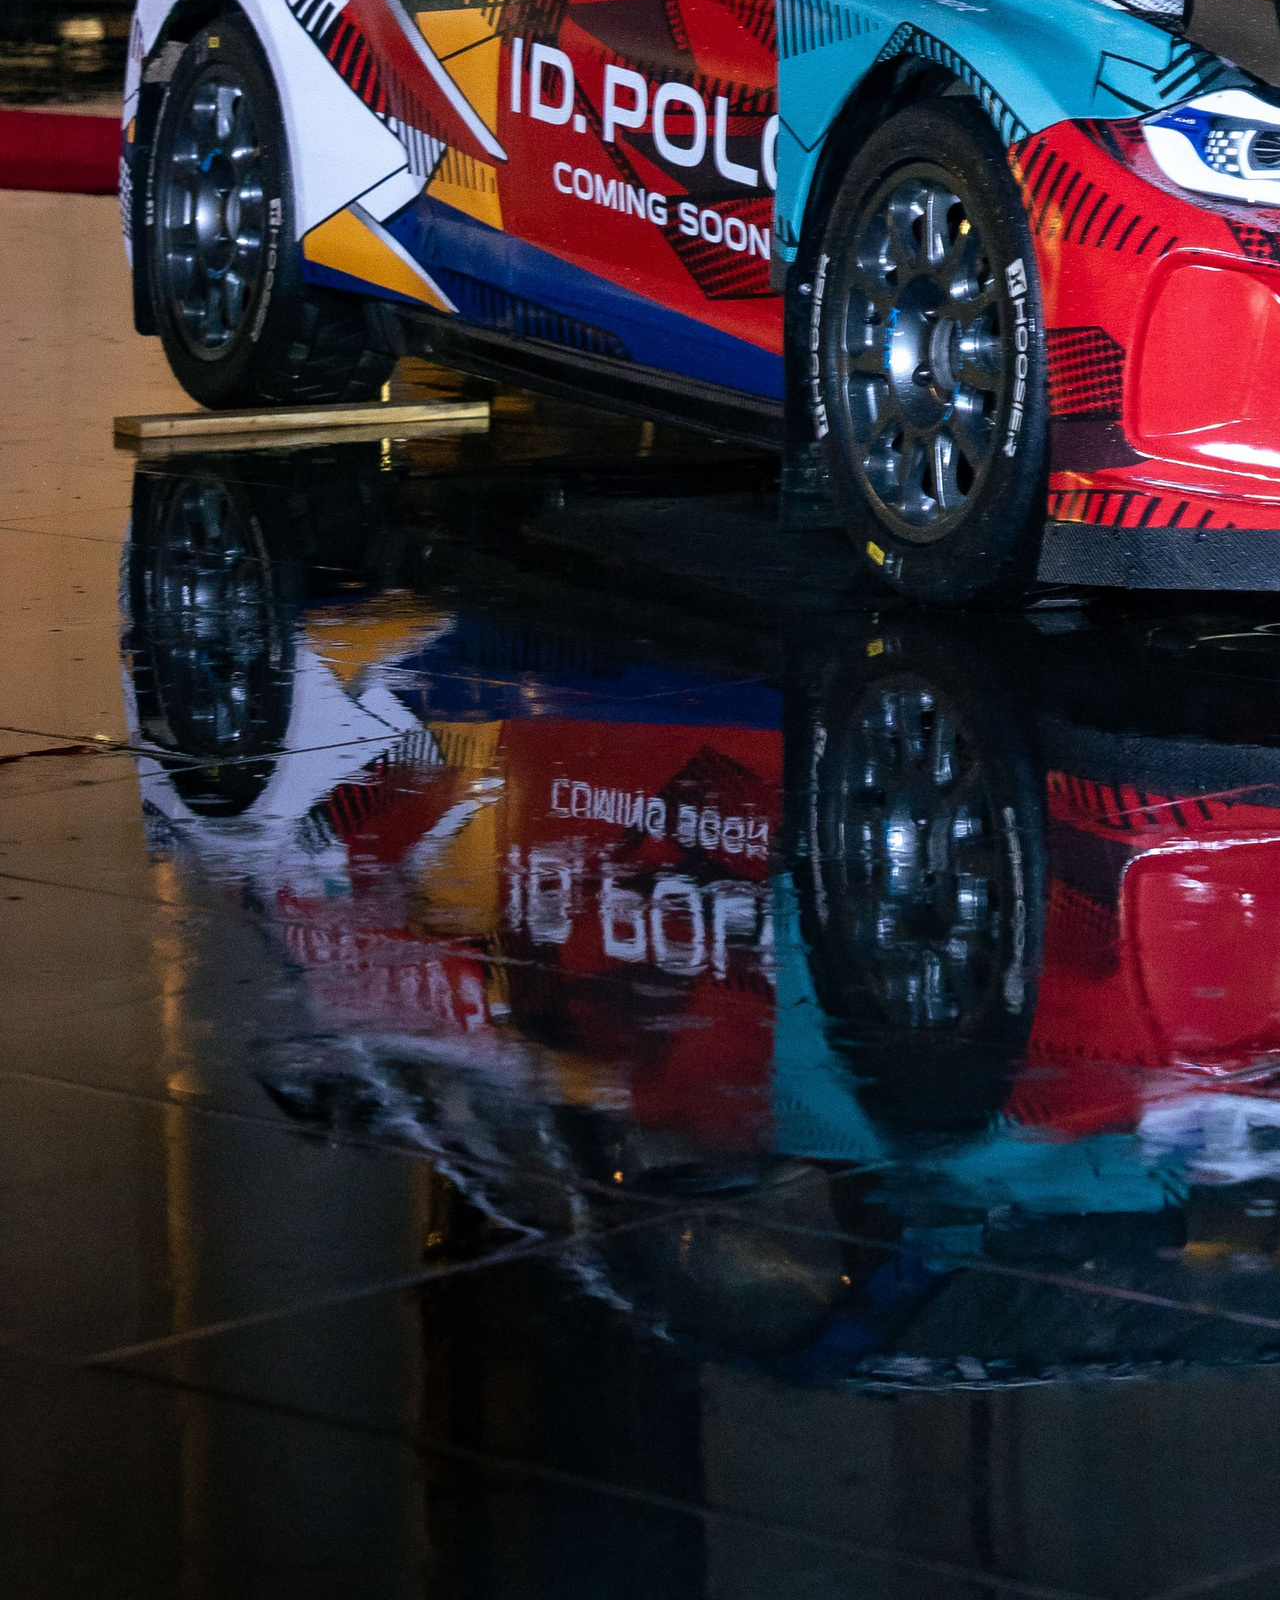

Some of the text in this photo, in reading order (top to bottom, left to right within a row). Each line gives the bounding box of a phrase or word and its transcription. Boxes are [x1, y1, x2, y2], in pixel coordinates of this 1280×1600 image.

[510, 36, 779, 191] ID. POL
[553, 162, 771, 261] COMING SOON
